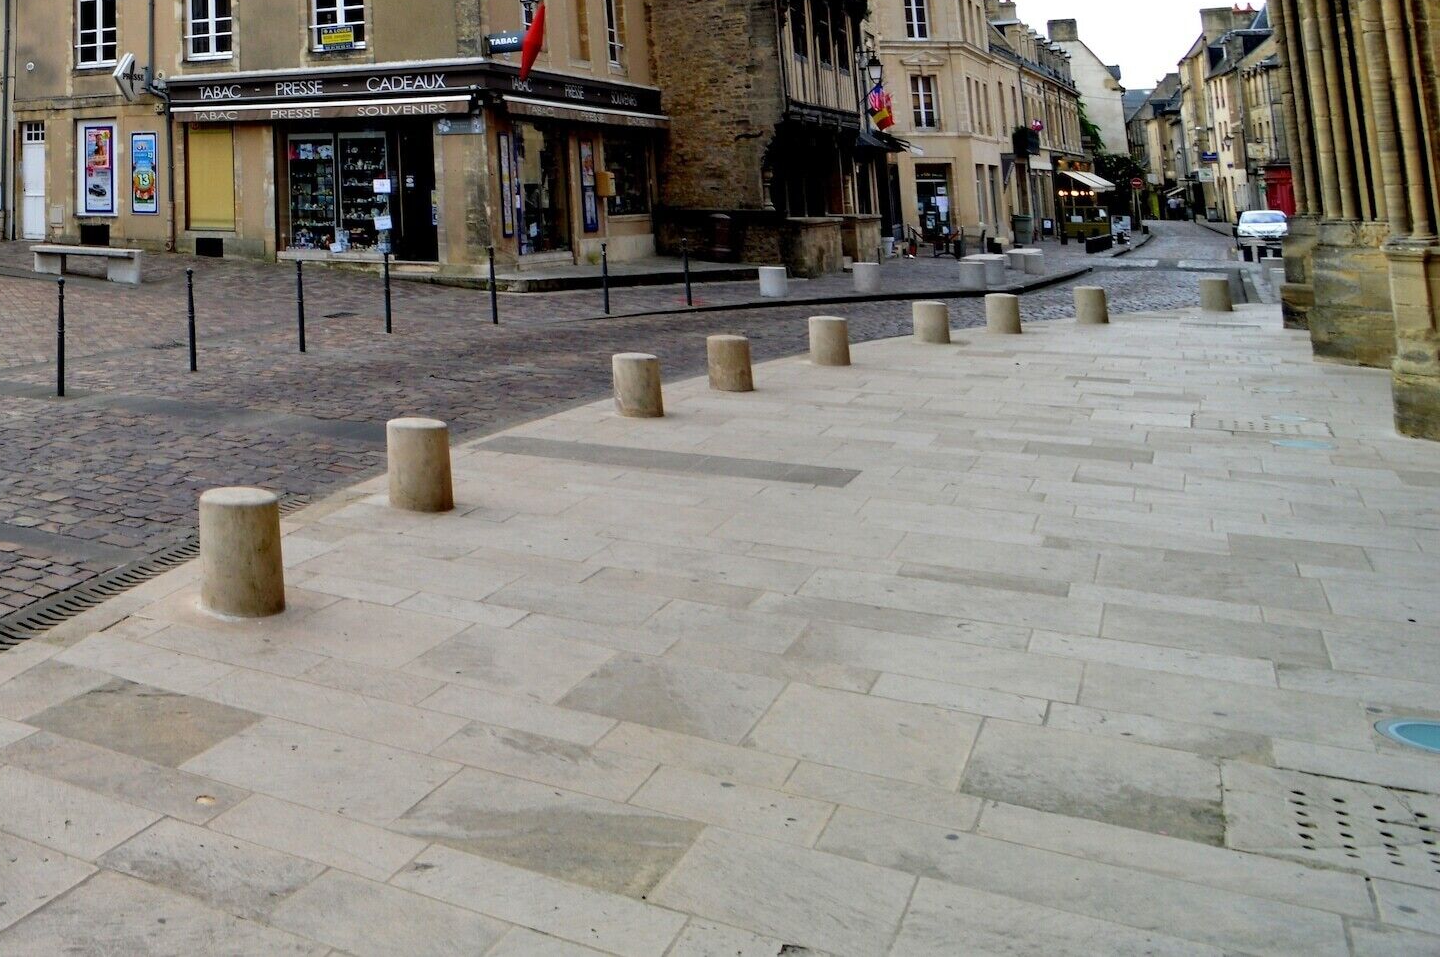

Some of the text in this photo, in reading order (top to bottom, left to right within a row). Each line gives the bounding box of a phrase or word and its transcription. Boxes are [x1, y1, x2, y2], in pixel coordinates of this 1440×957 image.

[490, 37, 518, 46] TABAC
[122, 72, 145, 82] PRESSE
[199, 84, 242, 100] TABAC
[275, 80, 324, 96] PRESSE
[366, 73, 447, 92] CADEAUX
[564, 83, 585, 100] PRESSE
[194, 103, 447, 120] TABAC PRESSE SOUVENIRS
[137, 173, 150, 186] 13
